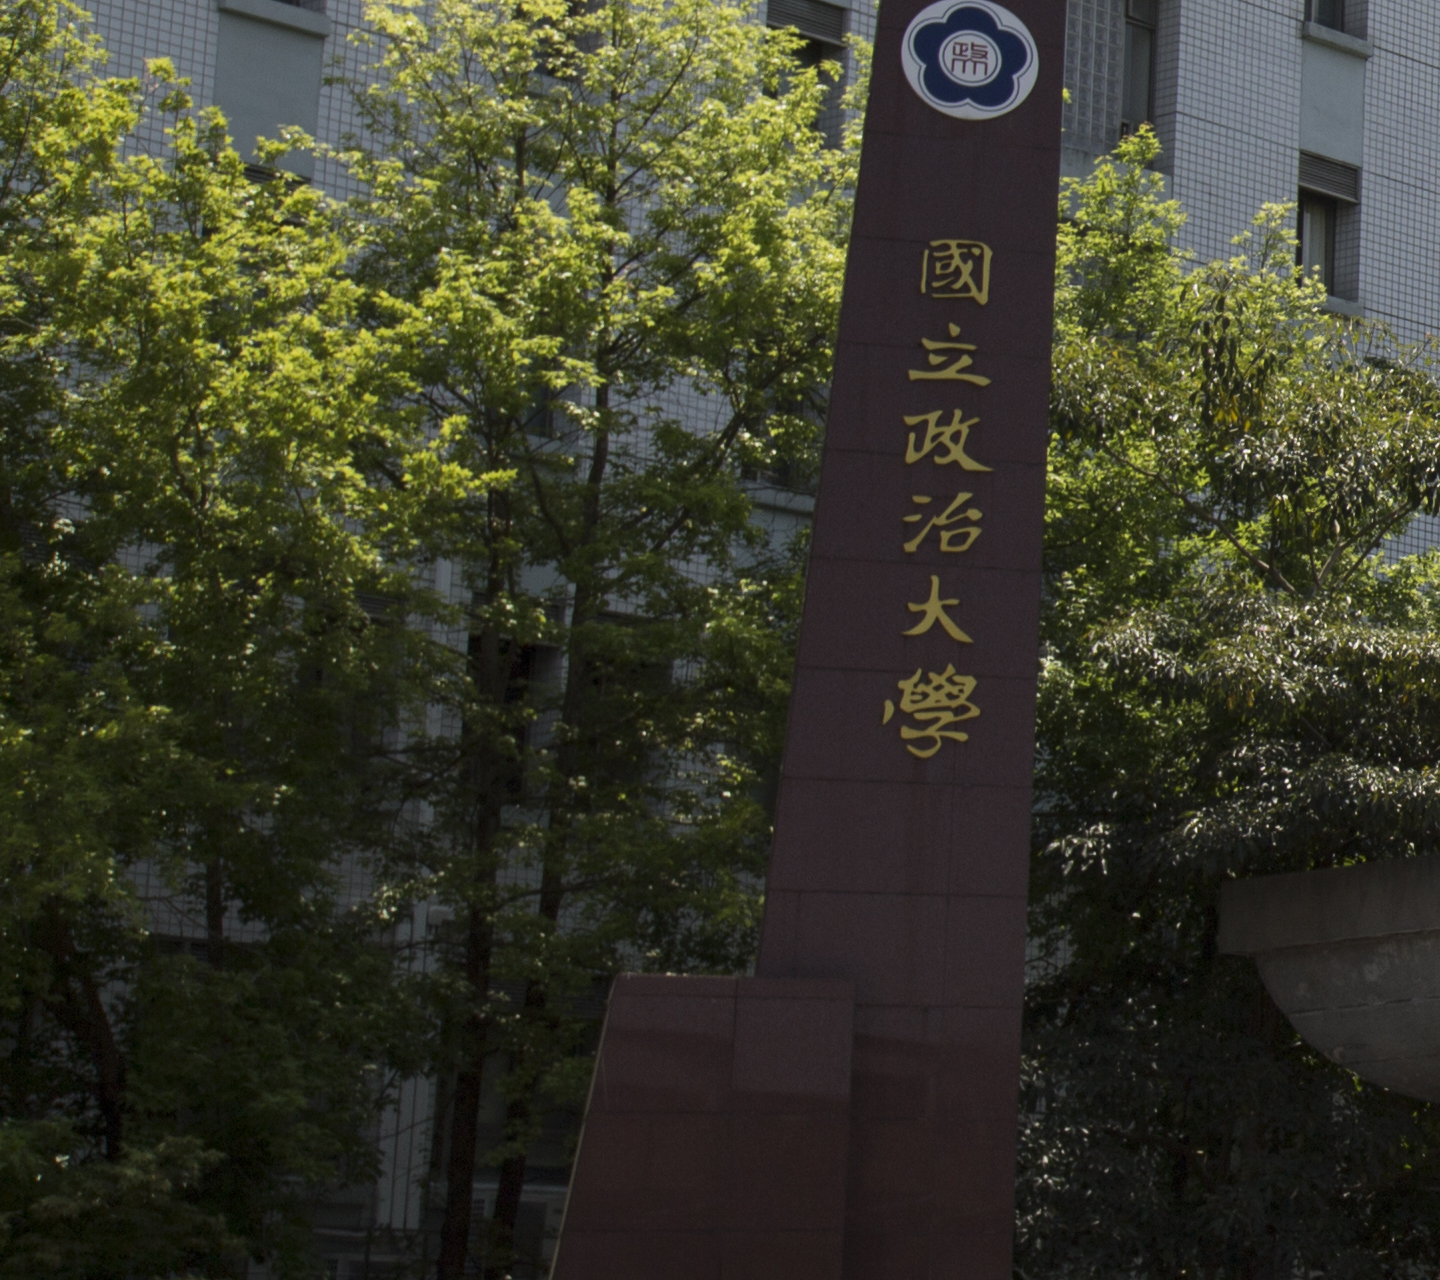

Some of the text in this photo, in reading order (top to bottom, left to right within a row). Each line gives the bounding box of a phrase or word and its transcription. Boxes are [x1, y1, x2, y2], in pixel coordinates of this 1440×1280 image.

[883, 239, 994, 760] 國立政治大學
